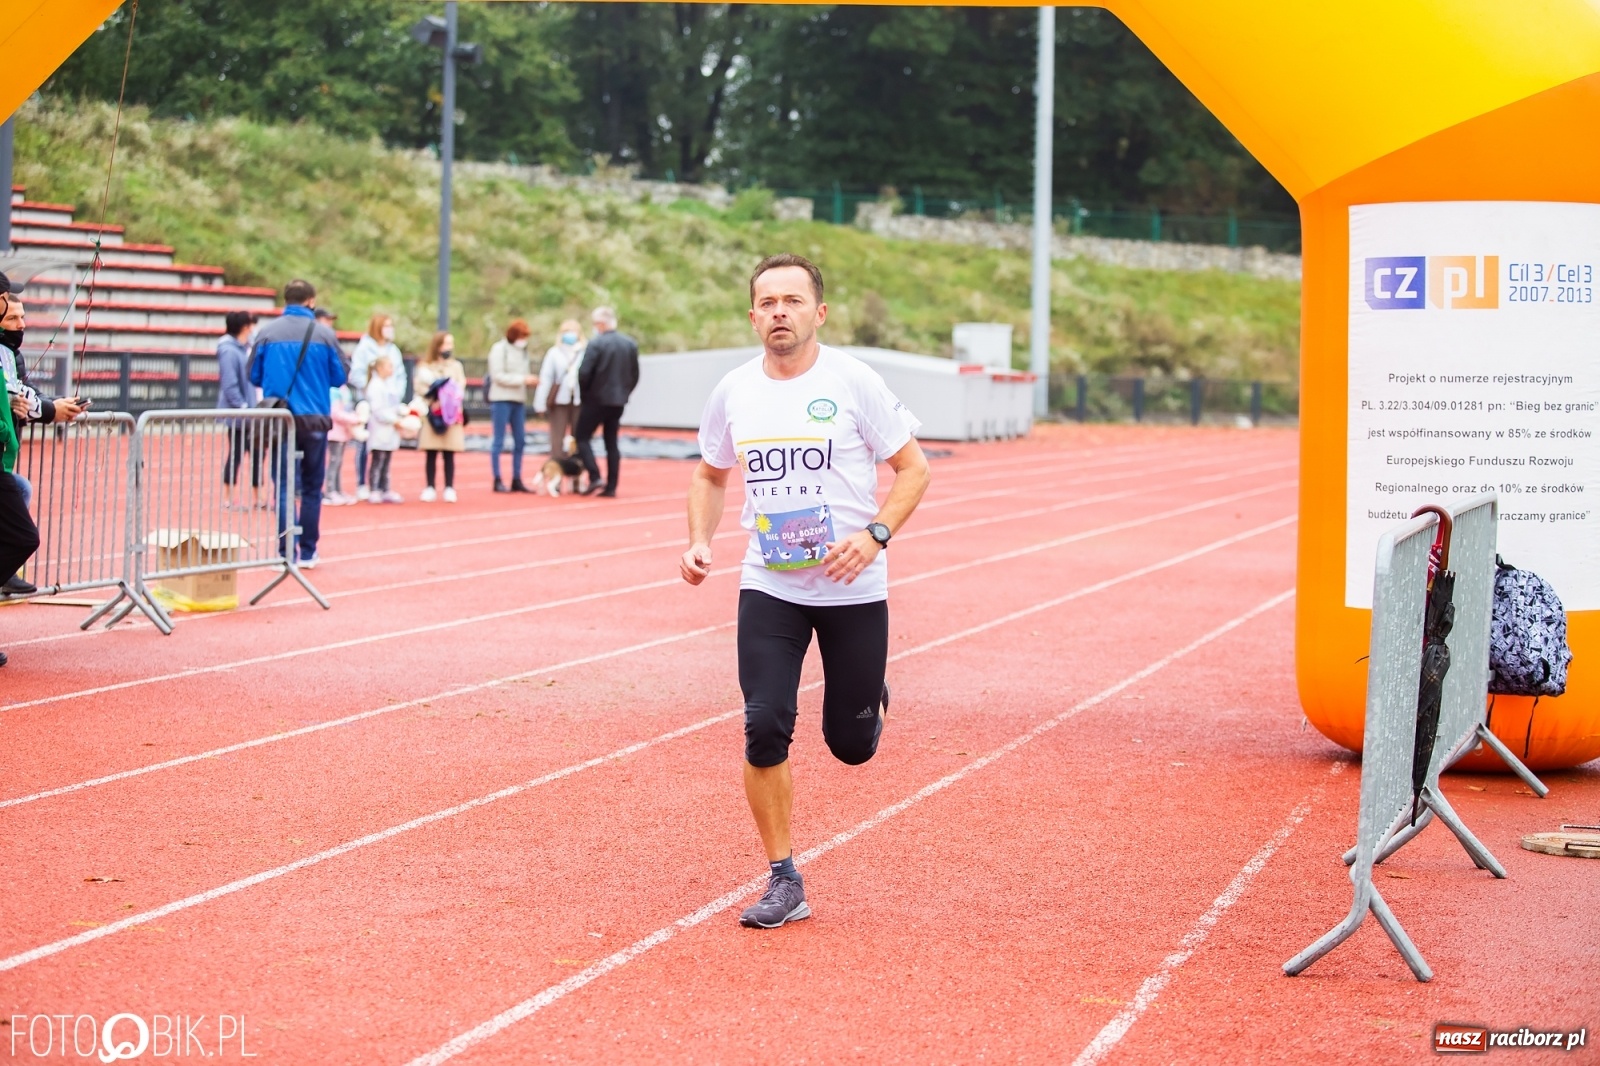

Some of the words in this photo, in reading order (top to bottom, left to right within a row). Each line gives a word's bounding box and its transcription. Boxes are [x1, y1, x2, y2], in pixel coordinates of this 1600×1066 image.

[1509, 263, 1529, 282] Cíl
[1557, 264, 1580, 283] Cel
[1388, 373, 1426, 386] Projekt
[1429, 376, 1437, 384] o
[1440, 375, 1489, 384] numerze
[1493, 373, 1573, 386] rejestracyjnym
[1361, 401, 1376, 411] PL.
[1379, 400, 1483, 411] 3.22/3.304/09.01281
[1488, 403, 1506, 413] pn:
[1544, 401, 1562, 411] bez
[1367, 428, 1386, 440] jest
[1388, 427, 1492, 441] współfinansowany
[1495, 430, 1505, 438] w
[1508, 428, 1532, 439] 85%
[1535, 430, 1547, 438] ze
[1550, 427, 1592, 439] środków
[746, 439, 832, 483] agrol
[1386, 455, 1466, 467] Europejskiego
[1469, 456, 1526, 466] Funduszu
[1529, 456, 1574, 468] Rozwoju
[752, 486, 823, 497] KIETRZ
[1375, 482, 1449, 494] Regionalnego
[1452, 485, 1477, 494] oraz
[1499, 483, 1523, 494] 10%
[1525, 485, 1538, 494] ze
[1541, 482, 1585, 494] środków
[1368, 509, 1408, 520] budżetu
[782, 531, 795, 540] DLA
